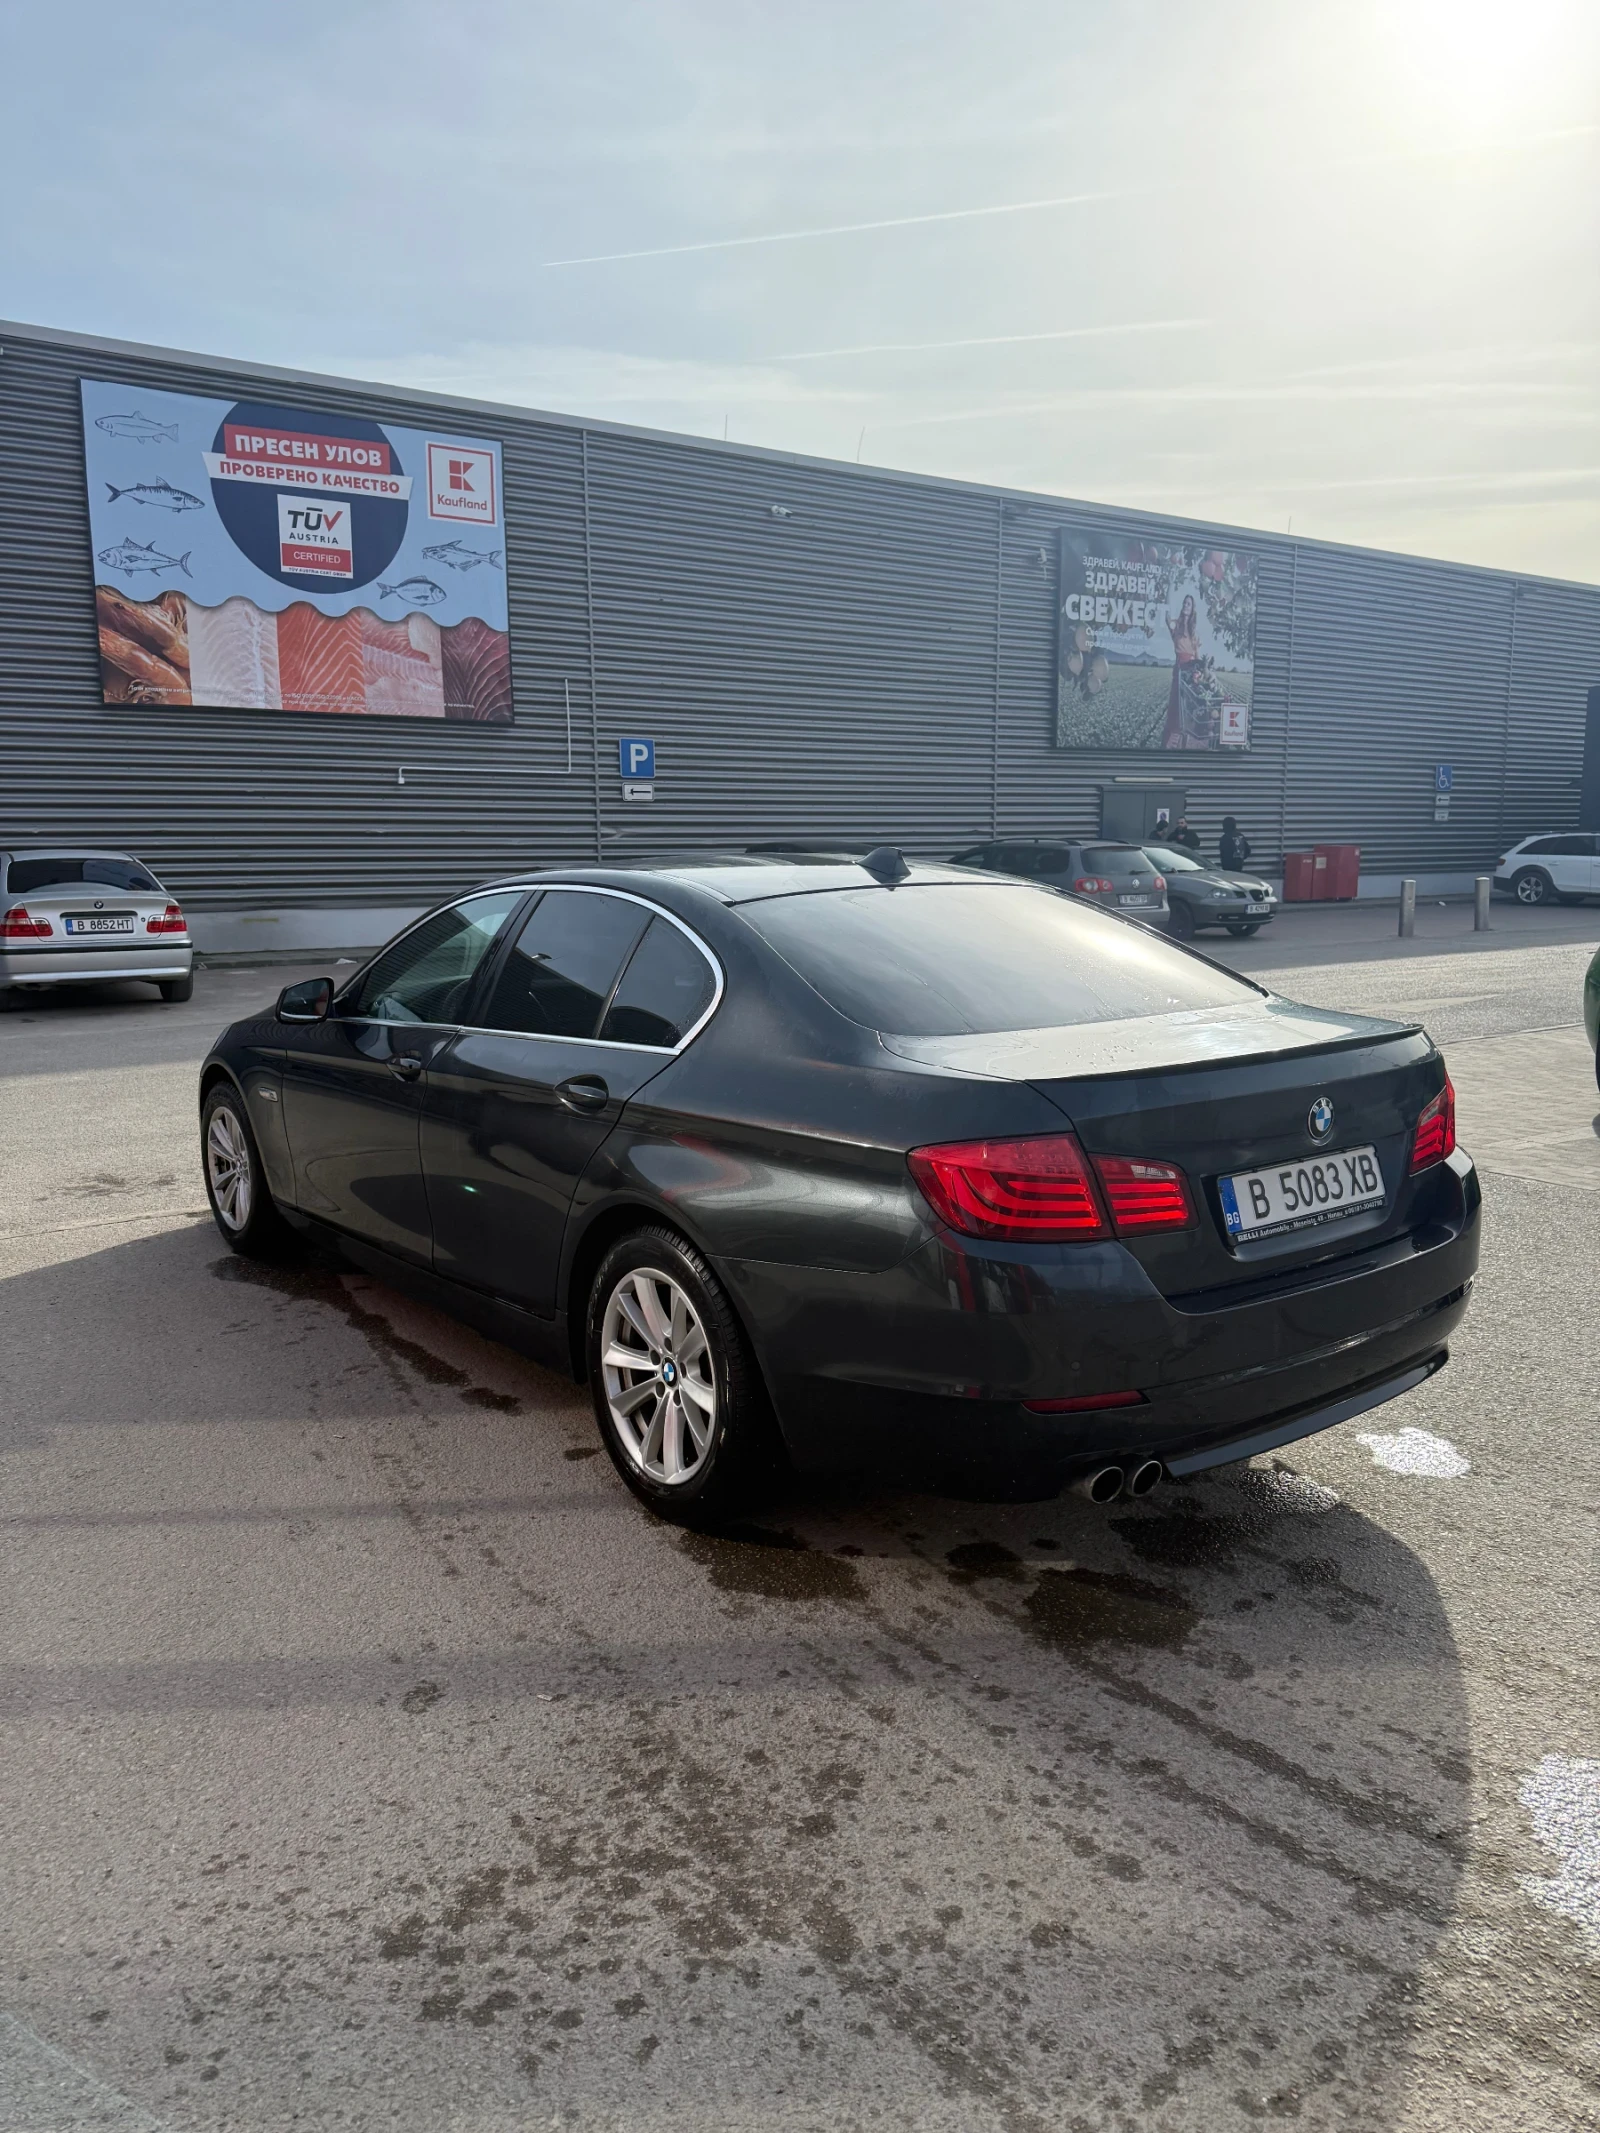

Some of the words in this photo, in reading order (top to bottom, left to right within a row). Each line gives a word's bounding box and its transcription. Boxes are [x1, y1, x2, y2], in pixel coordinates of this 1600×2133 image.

[235, 434, 319, 459] ПРЕСЕН
[325, 445, 382, 467] УЛОВ
[220, 460, 318, 483] ПРОВЕРЕНО
[322, 474, 400, 494] КАЧЕСТВО
[437, 493, 488, 511] Kaufland
[289, 532, 339, 545] AUSTRIA
[293, 551, 341, 565] CERTIFIED
[1065, 594, 1170, 628] СВЕЖЕСТ
[629, 743, 649, 773] P
[77, 921, 85, 930] B
[90, 920, 116, 930] 8852
[117, 919, 131, 929] HT
[1248, 1178, 1271, 1220] B
[1279, 1162, 1344, 1212] 5083
[1343, 1154, 1378, 1196] XB
[1226, 1211, 1240, 1226] BG
[1237, 1232, 1259, 1242] BELLI
